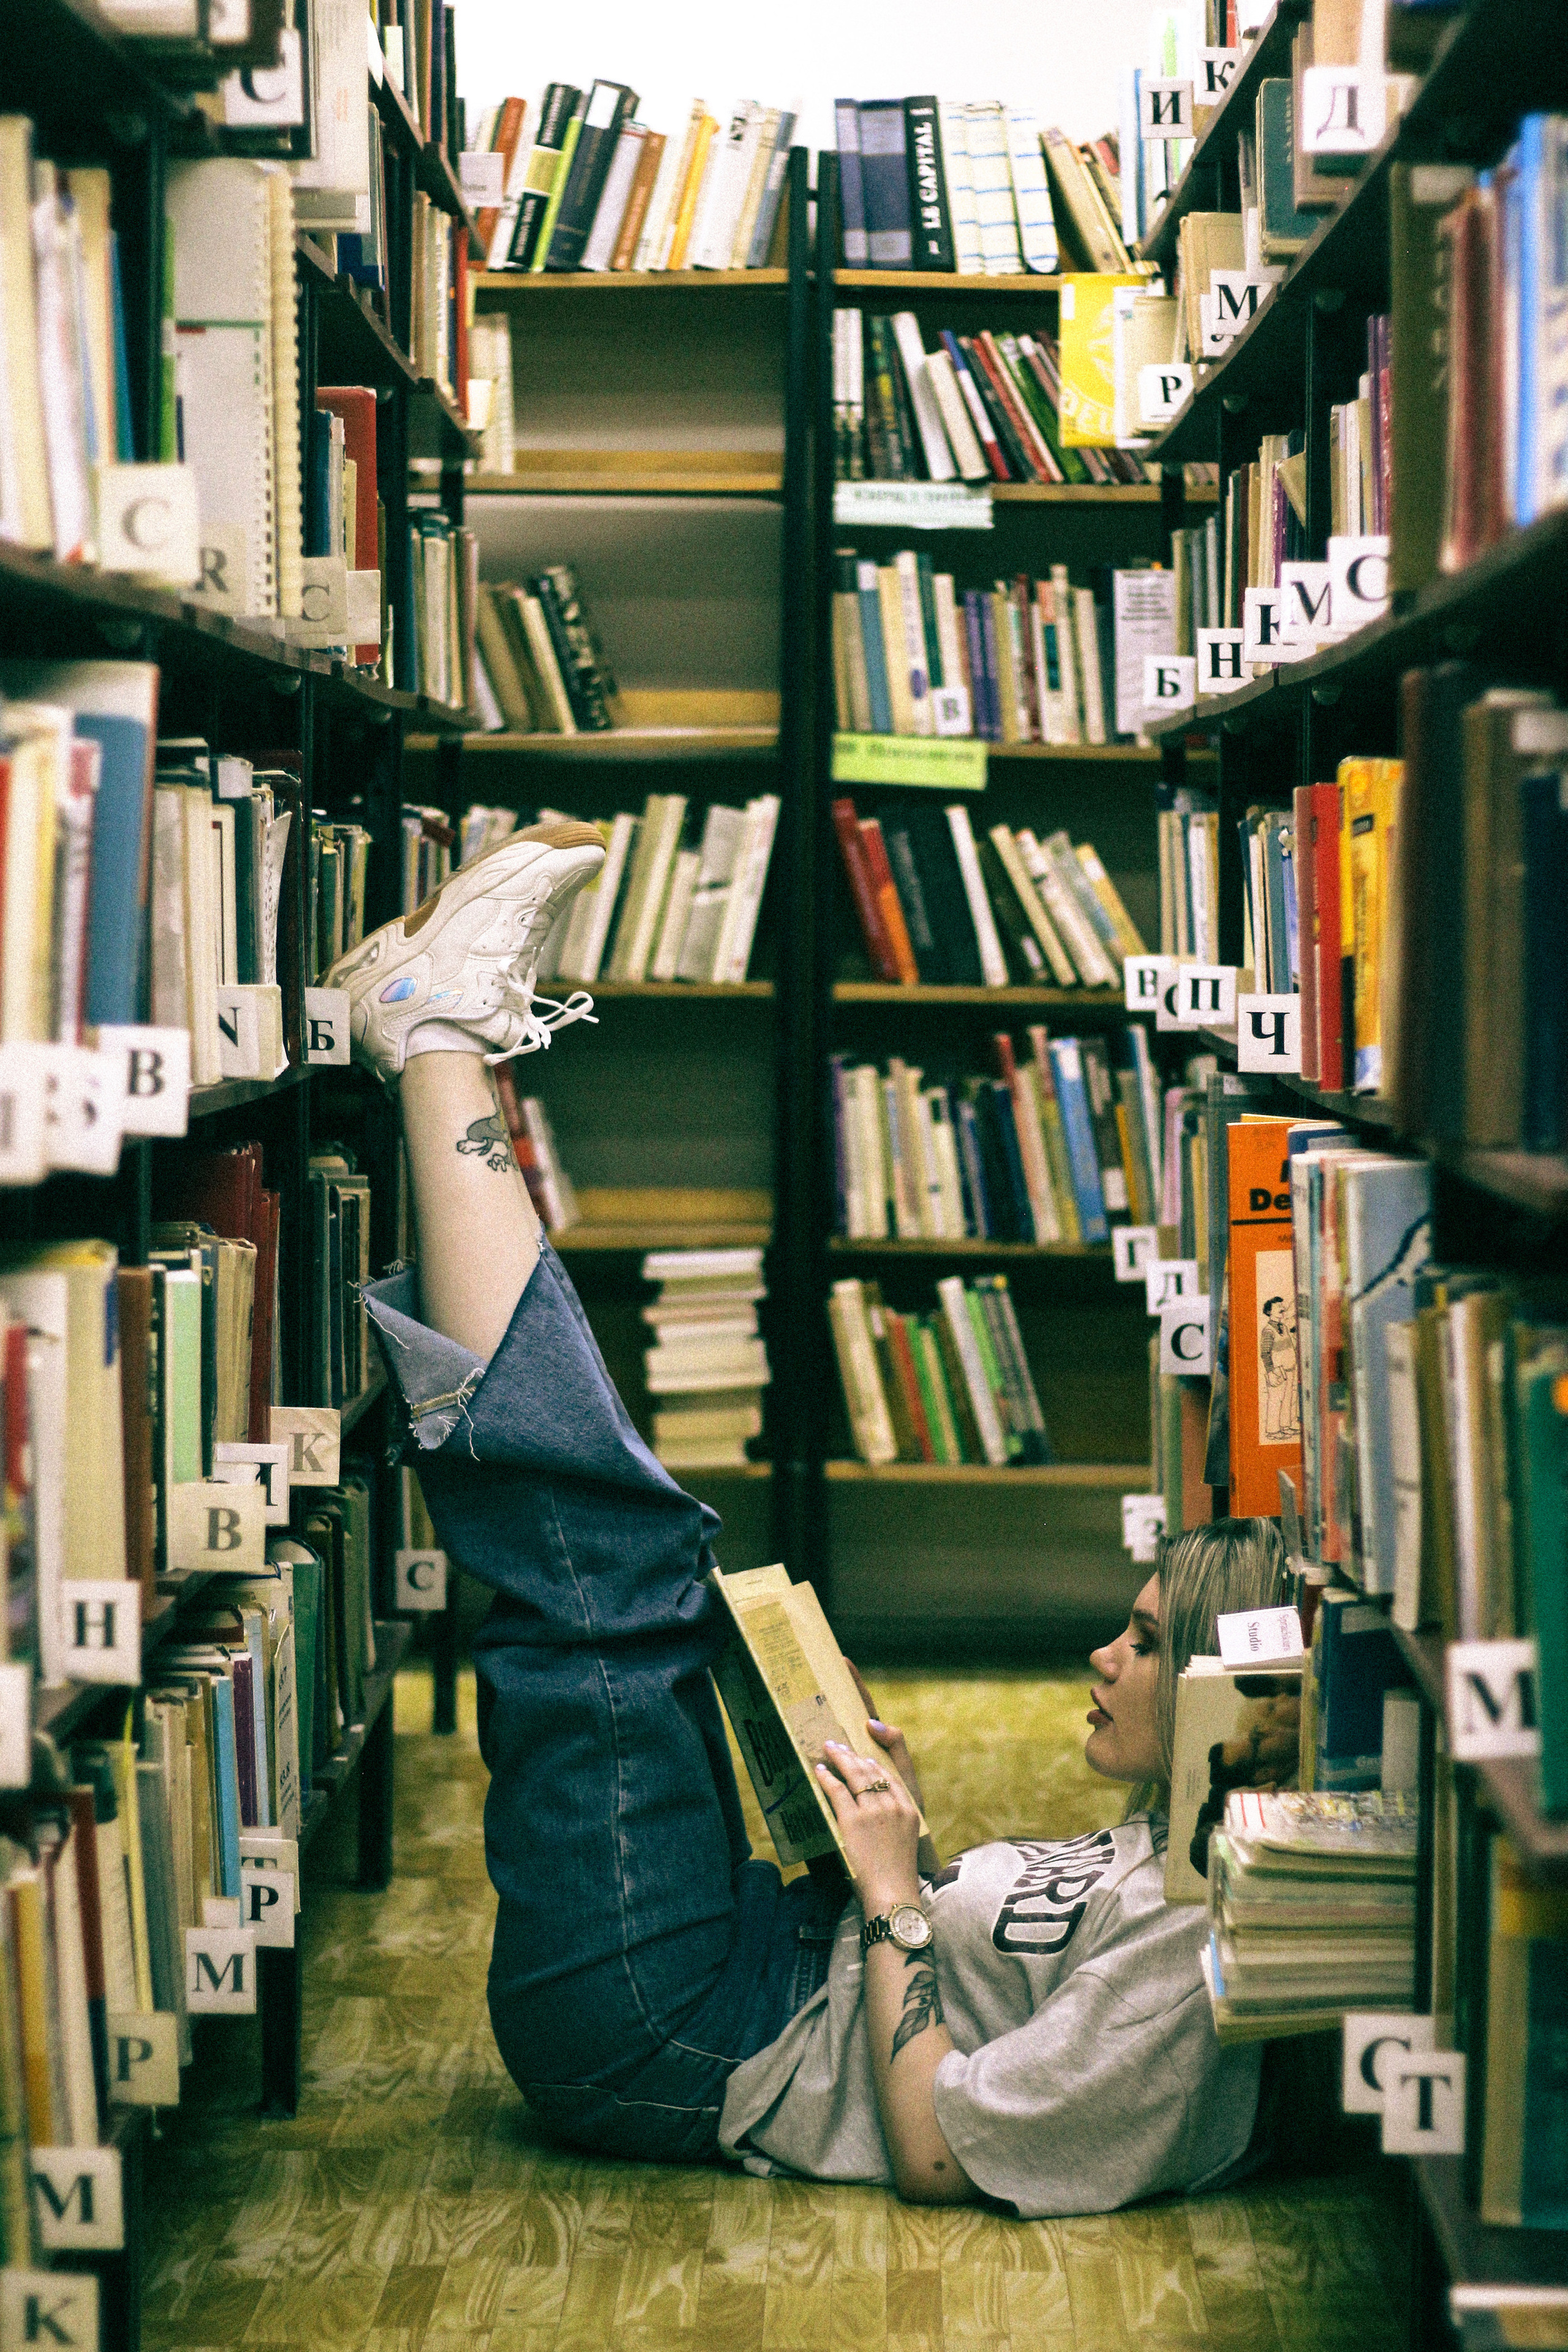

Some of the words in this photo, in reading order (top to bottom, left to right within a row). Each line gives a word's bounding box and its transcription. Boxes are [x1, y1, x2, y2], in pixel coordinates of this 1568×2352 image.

[1152, 90, 1184, 124] И
[1316, 85, 1365, 141] Д
[914, 121, 938, 203] CAPITAL
[923, 207, 941, 229] LE
[195, 547, 229, 593] R
[1156, 668, 1180, 697] Б
[1191, 978, 1221, 1010] П
[307, 1019, 335, 1050] Б
[1246, 1012, 1291, 1055] Ч
[1247, 1621, 1260, 1652] Studio
